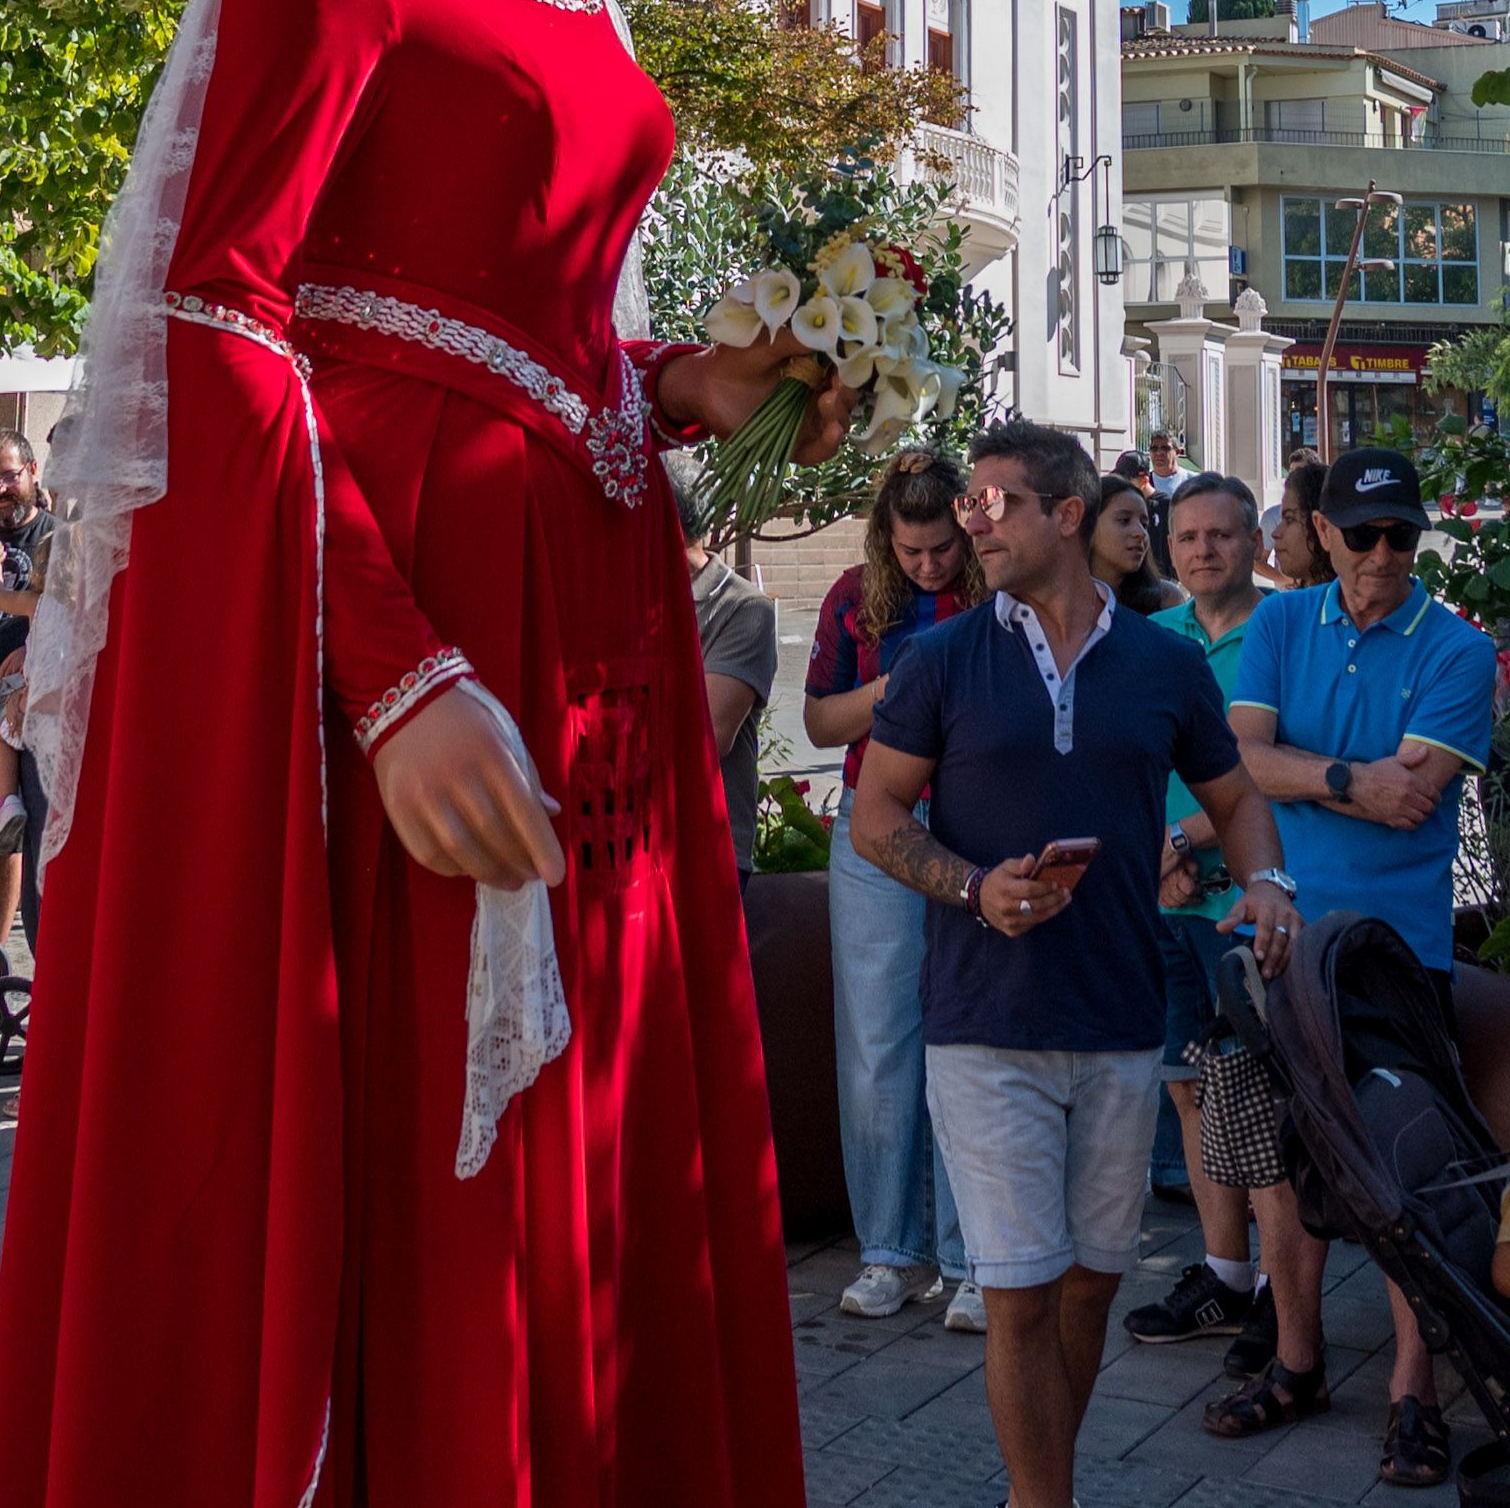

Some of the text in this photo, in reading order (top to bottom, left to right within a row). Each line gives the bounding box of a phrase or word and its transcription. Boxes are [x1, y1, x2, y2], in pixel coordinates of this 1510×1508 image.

[1292, 355, 1337, 367] TABAS
[1366, 358, 1410, 369] TIMBRE
[1364, 468, 1392, 483] NIKE
